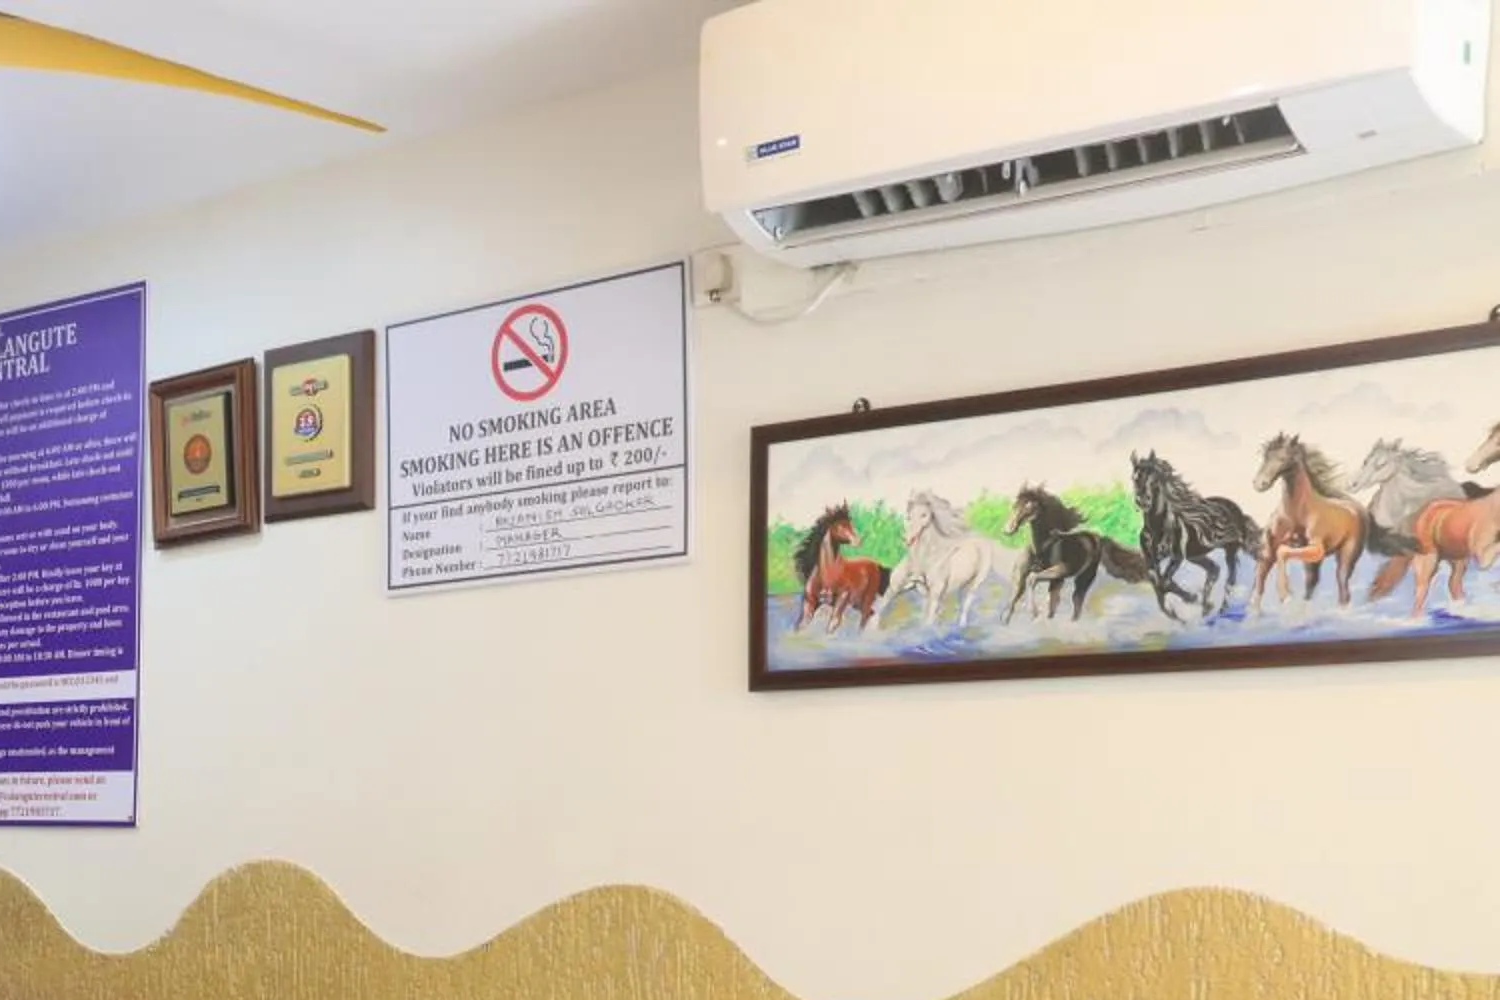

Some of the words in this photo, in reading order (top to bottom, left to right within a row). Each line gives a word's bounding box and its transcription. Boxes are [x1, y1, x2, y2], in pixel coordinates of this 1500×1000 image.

[449, 422, 473, 443] NO
[478, 406, 562, 439] SMOKING
[566, 397, 617, 424] AREA
[400, 449, 480, 479] SMOKING
[484, 440, 533, 466] HERE
[537, 436, 554, 457] IS
[557, 430, 583, 453] AN
[588, 417, 673, 448] OFFENCE
[412, 471, 473, 497] Violators
[477, 465, 503, 487] will
[505, 462, 523, 483] be
[526, 455, 563, 480] fined
[566, 459, 586, 478] up
[589, 453, 603, 471] to
[517, 489, 567, 508] smoking
[571, 483, 609, 503] please
[612, 475, 652, 496] report
[402, 529, 431, 542] Name
[402, 543, 462, 561] Designation
